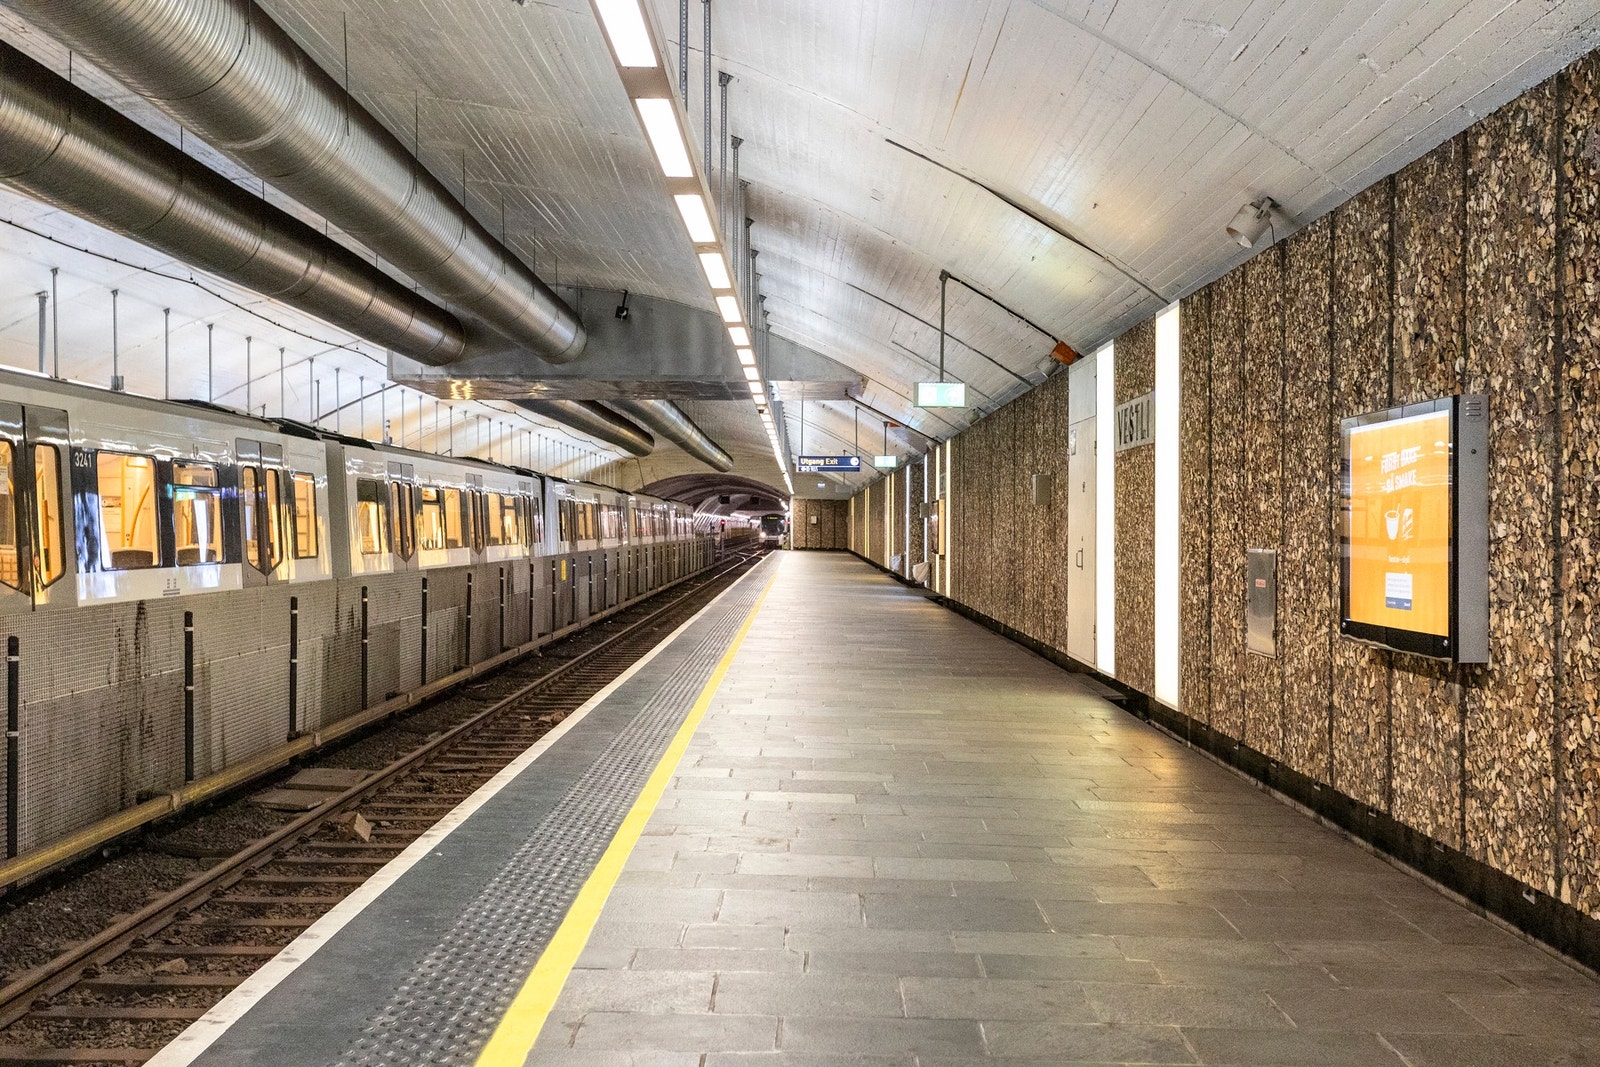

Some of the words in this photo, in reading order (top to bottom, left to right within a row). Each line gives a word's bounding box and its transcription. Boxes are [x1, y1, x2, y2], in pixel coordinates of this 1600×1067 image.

[1117, 399, 1150, 446] VESTLI
[74, 451, 92, 468] 3241
[800, 458, 825, 466] Utgang
[825, 457, 839, 465] Exit
